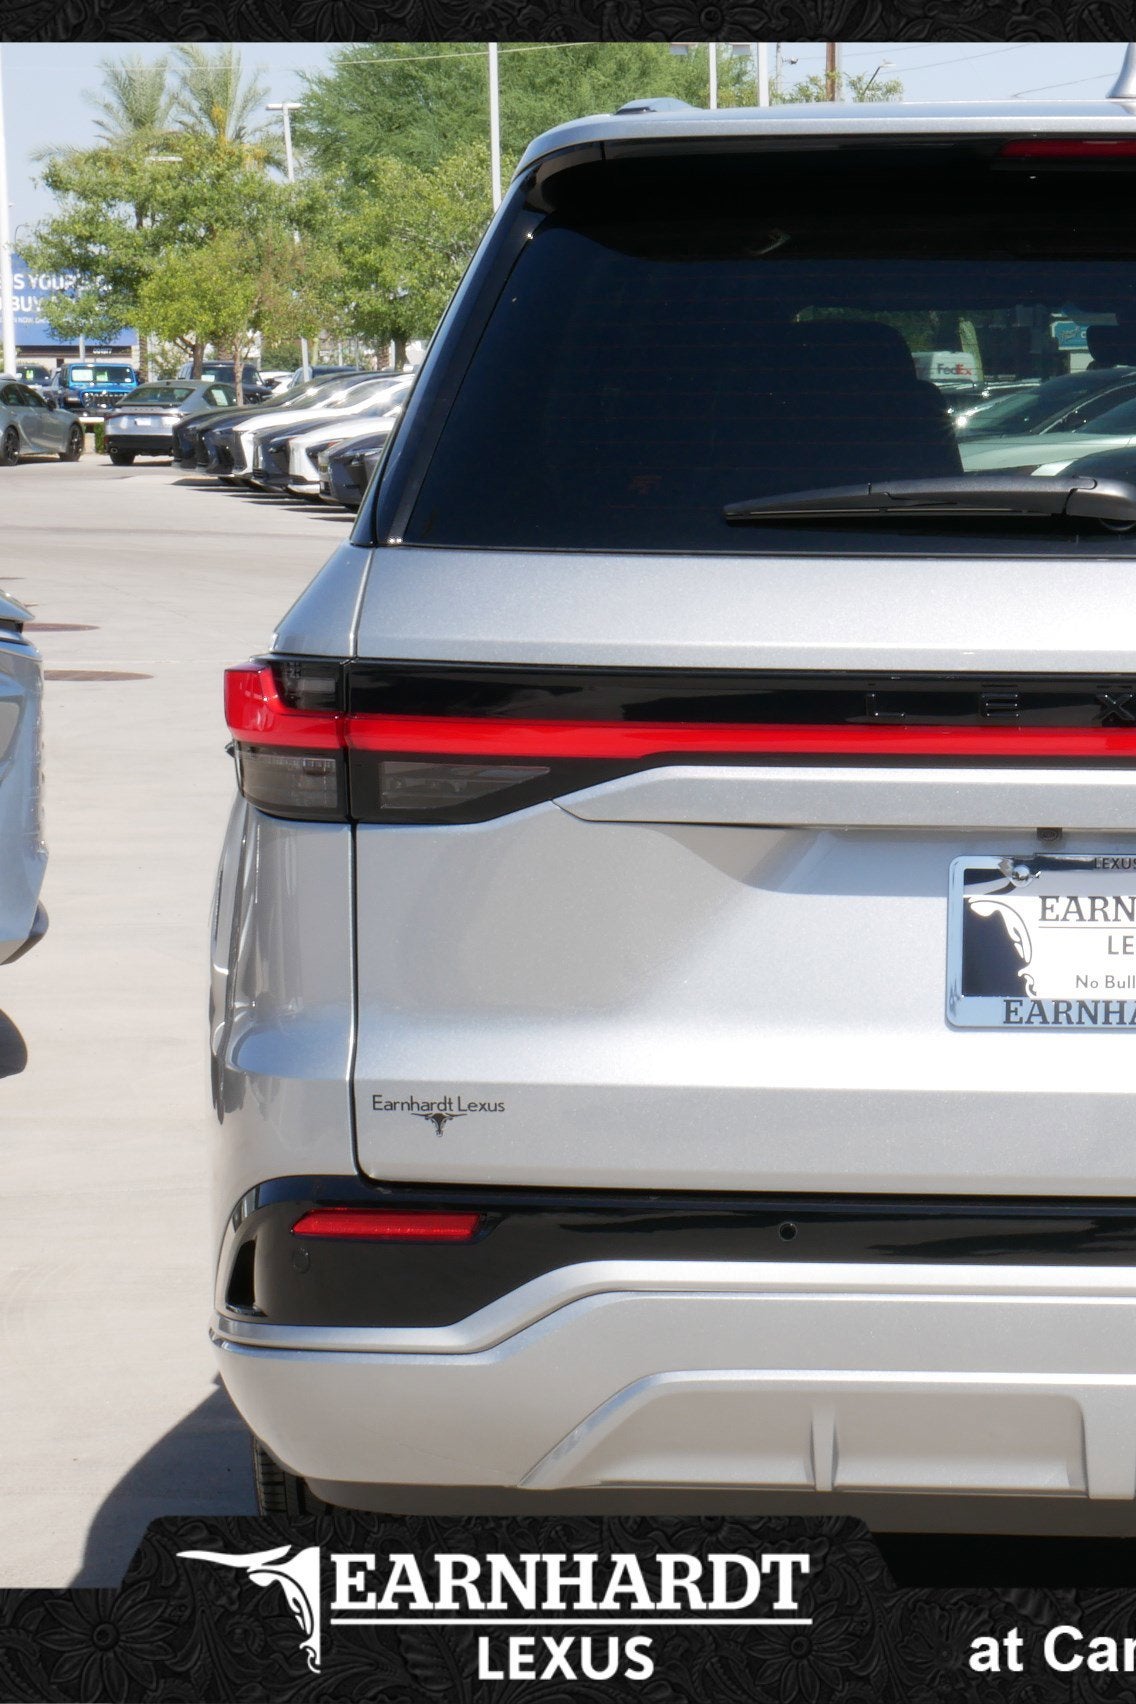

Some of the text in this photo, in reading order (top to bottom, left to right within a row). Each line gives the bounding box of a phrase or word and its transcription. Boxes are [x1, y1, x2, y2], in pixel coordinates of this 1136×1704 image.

[937, 363, 973, 376] FedEx
[1076, 975, 1099, 989] No
[1105, 974, 1136, 990] Bull
[372, 1095, 505, 1112] Earnhardt Lexus
